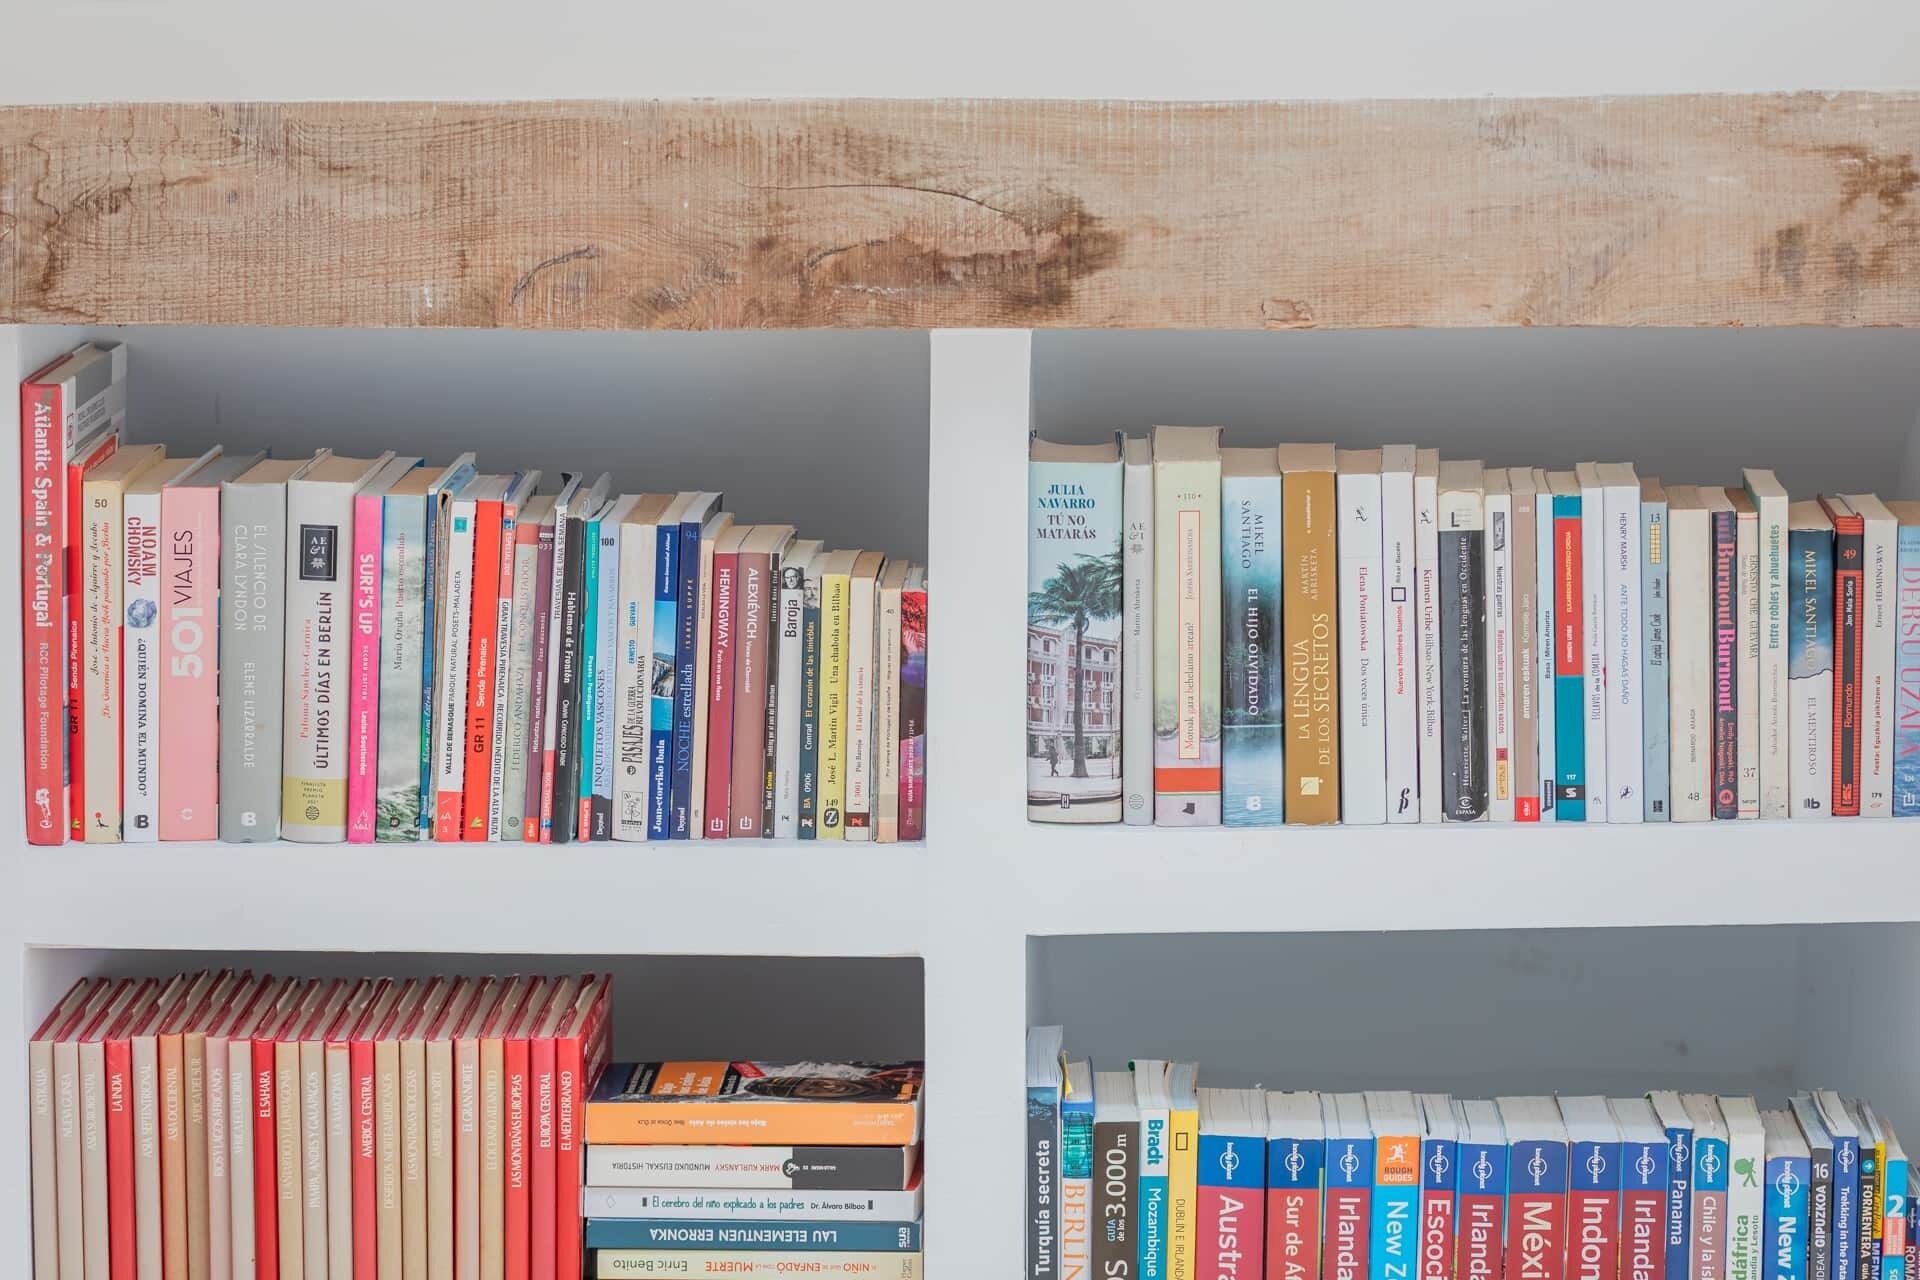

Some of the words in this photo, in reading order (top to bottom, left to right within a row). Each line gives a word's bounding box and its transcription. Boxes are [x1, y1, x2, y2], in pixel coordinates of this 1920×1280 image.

[33, 402, 52, 474] Atlantic
[32, 478, 51, 527] Spain
[94, 498, 108, 509] 50
[1037, 497, 1097, 510] NAVARRO
[1047, 484, 1086, 496] JULIA
[1036, 524, 1098, 541] MATARÁS
[1047, 510, 1066, 526] TÚ
[1067, 513, 1086, 527] NO
[1239, 499, 1252, 569] SANTIAGO
[1618, 511, 1628, 540] HENRY
[33, 533, 52, 547] &
[234, 525, 248, 572] CLARA
[1253, 513, 1264, 556] MIKEL
[127, 516, 142, 586] CHOMSKY
[141, 525, 157, 577] NOAM
[1618, 541, 1628, 571] MARSH
[1768, 524, 1780, 581] ahuehuetes
[1843, 548, 1857, 560] 49
[173, 530, 194, 606] VIAJES
[1300, 554, 1311, 595] MARTÍN
[1309, 547, 1319, 601] ABRISKETA
[1804, 550, 1816, 595] MIKEL
[32, 554, 53, 628] Portugal
[830, 583, 842, 613] Bilbao
[1247, 588, 1259, 602] EL
[1423, 568, 1433, 604] Kirmen
[1619, 583, 1629, 605] ANTE
[1718, 542, 1736, 626] Burnout
[234, 574, 248, 631] LYNDON
[316, 591, 332, 643] BERLÍN
[564, 592, 576, 634] Hablemos
[717, 568, 731, 648] HEMINGWAY
[745, 568, 760, 639] ALEXIÉVICH
[1424, 605, 1434, 631] Uribe
[1768, 591, 1779, 621] robles
[1901, 566, 1920, 656] DERSU
[784, 599, 799, 638] Baroja
[833, 614, 841, 626] en
[1246, 606, 1259, 637] HIJO
[1619, 606, 1629, 633] TODO
[1805, 597, 1817, 668] SANTIAGO
[171, 607, 204, 679] 501
[564, 635, 574, 649] de
[830, 628, 841, 663] chabola
[1619, 634, 1629, 646] NO
[1768, 624, 1779, 649] Entre
[137, 638, 149, 680] ¿QUIÉN
[316, 648, 330, 666] EN
[477, 638, 489, 679] Pirenaica
[563, 651, 574, 684] Frontón
[1311, 612, 1331, 713] SECRETOS
[1425, 632, 1435, 684] Bilbao-New
[1619, 647, 1629, 678] HAGAS
[1717, 629, 1735, 713] Burnout
[314, 671, 330, 703] DÍAS
[830, 664, 840, 684] Una
[1247, 642, 1260, 715] OLVIDADO
[1293, 639, 1311, 719] LENGUA
[138, 682, 148, 729] DOMINA
[476, 680, 487, 708] Senda
[680, 663, 694, 718] estrellada
[828, 693, 840, 716] Vigil
[1619, 678, 1631, 706] DAÑO
[1807, 697, 1817, 708] EL
[1843, 683, 1854, 728] Riomundo
[475, 717, 485, 730] 11
[1425, 685, 1436, 737] York-Bilbao
[1901, 667, 1920, 757] UZALA
[137, 732, 148, 745] EL
[314, 710, 330, 769] ÚLTIMOS
[474, 735, 485, 753] GR
[621, 725, 644, 764] PASAJES
[828, 717, 838, 749] Martín
[1298, 724, 1310, 740] LA
[1317, 717, 1330, 743] LOS
[1807, 710, 1818, 776] MENTIROSO
[655, 739, 666, 764] ibaia
[677, 720, 691, 772] NOCHE
[828, 752, 838, 762] L.
[1318, 746, 1330, 765] DE
[136, 746, 148, 797] MUNDO?
[826, 765, 838, 785] José
[652, 765, 666, 833] Joan-etorriko
[1687, 792, 1701, 801] 48
[111, 1073, 122, 1099] INDIA
[259, 1071, 271, 1106] SAHARA
[360, 1074, 372, 1116] CENTRAL
[510, 1074, 522, 1119] EUROPEAS
[539, 1072, 551, 1113] CENTRAL
[111, 1100, 123, 1112] LA
[259, 1108, 271, 1118] EL
[560, 1070, 572, 1140] MEDITERRANEO
[360, 1118, 373, 1159] AMERICA
[508, 1120, 522, 1170] MONTAÑAS
[540, 1114, 552, 1148] EUROPA
[561, 1142, 572, 1151] EL
[1147, 1119, 1164, 1166] Bradt
[511, 1171, 522, 1187] LAS
[611, 1161, 644, 1171] HISTORIA
[644, 1161, 674, 1171] EUSKAL
[674, 1161, 711, 1171] MUNDUKO
[714, 1162, 759, 1172] KURLANSKY
[759, 1162, 782, 1172] MARK
[1035, 1139, 1050, 1205] secreta
[1105, 1148, 1127, 1218] 3.000
[1116, 1133, 1127, 1148] m
[1383, 1174, 1413, 1182] GUIDES
[1384, 1167, 1413, 1175] ROUGH
[1813, 1163, 1829, 1178] 16
[652, 1195, 660, 1209] El
[662, 1197, 690, 1209] cerebro
[693, 1196, 704, 1209] del
[706, 1197, 721, 1210] niño
[723, 1197, 758, 1214] explicado
[768, 1198, 778, 1210] los
[780, 1198, 805, 1214] padres
[1670, 1180, 1687, 1245] Panama
[1702, 1197, 1717, 1233] Chile
[1814, 1185, 1827, 1248] GIPUZKOA
[1838, 1186, 1850, 1229] Trekking
[1887, 1194, 1905, 1218] 2
[648, 1227, 715, 1241] ERRONKA
[718, 1228, 809, 1243] ELEMENTUEN
[812, 1229, 838, 1243] LAU
[1062, 1184, 1088, 1280] BERLÍN
[1106, 1218, 1116, 1242] GUÍA
[1116, 1218, 1126, 1231] los
[1116, 1231, 1126, 1242] de
[1143, 1187, 1162, 1277] Mozambique
[1385, 1202, 1409, 1256] New
[1840, 1230, 1849, 1240] in
[1860, 1185, 1874, 1258] FORMENTERA
[898, 1226, 908, 1249] sua
[1034, 1208, 1054, 1276] Turquía
[1699, 1236, 1711, 1245] y
[1777, 1216, 1797, 1271] New
[1840, 1241, 1849, 1257] the
[612, 1258, 655, 1273] Benito
[654, 1258, 689, 1273] Enric
[704, 1261, 754, 1273] MUERTE
[776, 1261, 821, 1274] ENFADÓ
[842, 1260, 871, 1273] NIÑO
[1701, 1249, 1716, 1262] la
[1384, 1263, 1407, 1280] Z
